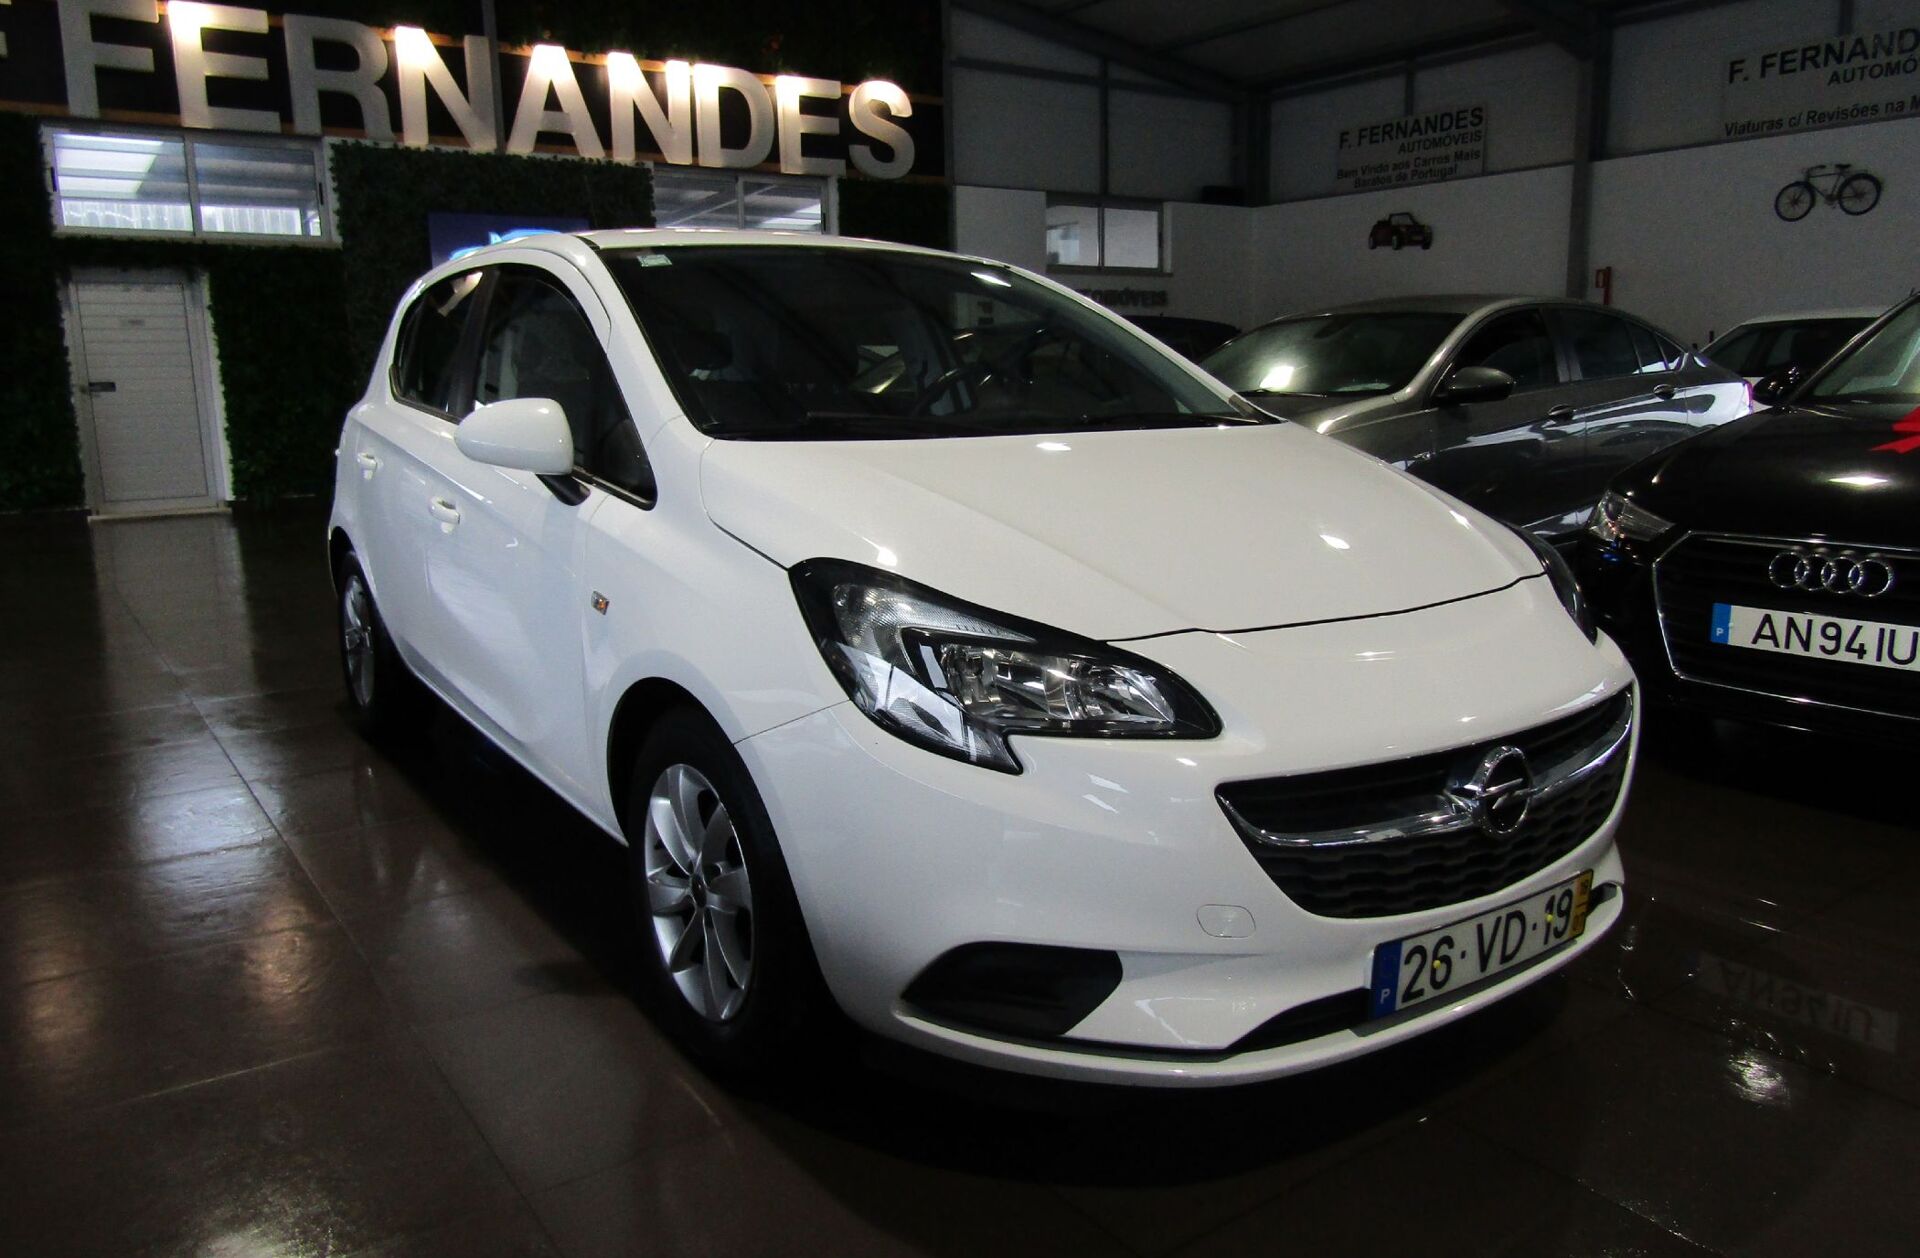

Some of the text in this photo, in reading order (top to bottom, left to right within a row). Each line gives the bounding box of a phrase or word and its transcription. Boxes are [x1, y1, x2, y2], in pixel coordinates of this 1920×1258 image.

[1728, 27, 1920, 84] F. FERNAND
[57, 0, 916, 181] FERNANDES
[1338, 106, 1484, 150] F. FERNANDES
[1724, 116, 1783, 137] Viaturas
[1788, 112, 1803, 128] c/
[1806, 101, 1879, 124] Revisões
[1884, 99, 1905, 114] na
[1397, 129, 1482, 155] AUTOMÓVEIS
[1336, 148, 1482, 181] Bem Vindo aos Carros Mais
[1353, 173, 1393, 189] Baratos
[1410, 164, 1458, 181] Portugal
[1716, 626, 1725, 637] P
[1379, 987, 1392, 1005] P
